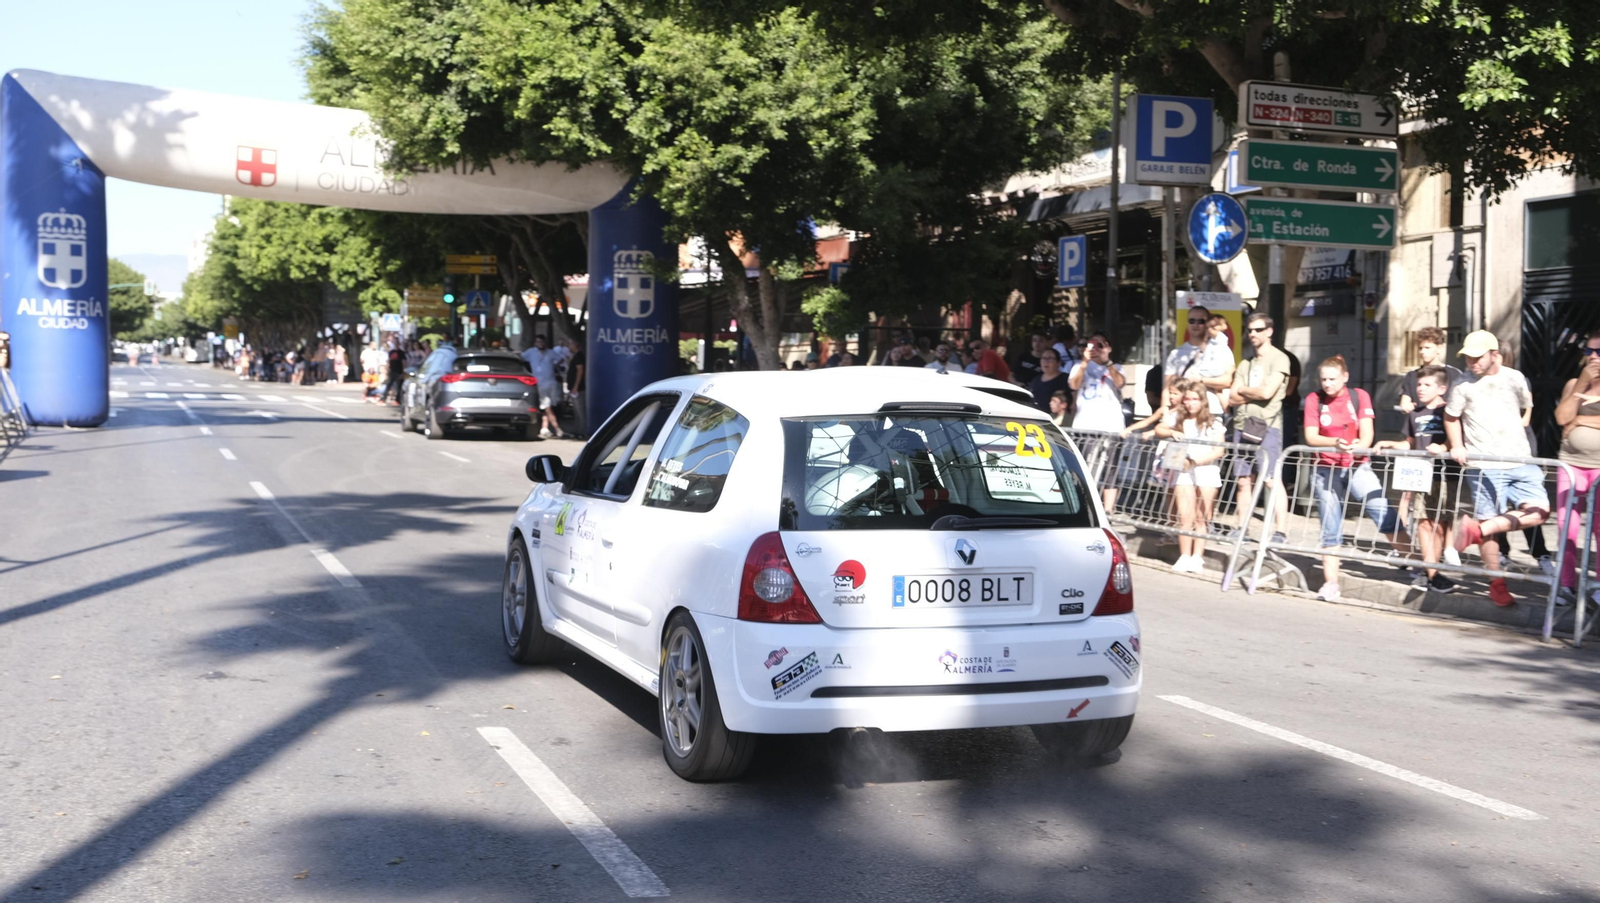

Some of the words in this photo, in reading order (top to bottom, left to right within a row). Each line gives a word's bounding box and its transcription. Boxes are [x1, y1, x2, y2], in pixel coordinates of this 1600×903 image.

[1254, 90, 1288, 103] todas
[1293, 93, 1360, 109] direcciones
[1295, 110, 1331, 122] N-340
[1336, 114, 1360, 125] E-15
[1151, 100, 1197, 157] P
[1140, 163, 1175, 175] GARAJE
[1179, 163, 1207, 176] BELÉN
[1251, 156, 1285, 170] Ctra.
[1293, 159, 1309, 171] de
[1317, 160, 1357, 175] Ronda
[317, 172, 410, 196] CIUDAD
[1249, 206, 1286, 218] avenida
[1291, 207, 1303, 218] de
[1248, 218, 1264, 233] La
[1272, 221, 1330, 238] Estación
[1063, 241, 1081, 282] P
[1315, 267, 1332, 281] 957
[1334, 266, 1352, 279] 416
[17, 297, 104, 318] ALMERÍA
[38, 317, 88, 330] CIUDAD
[597, 325, 669, 344] ALMERÍA
[612, 344, 654, 356] CIUDAD
[1006, 421, 1053, 459] 23
[908, 578, 971, 603] 0008
[981, 577, 1026, 602] BLT
[1061, 588, 1085, 598] Clio
[953, 663, 993, 674] ALMERÍA
[960, 656, 982, 664] COSTA
